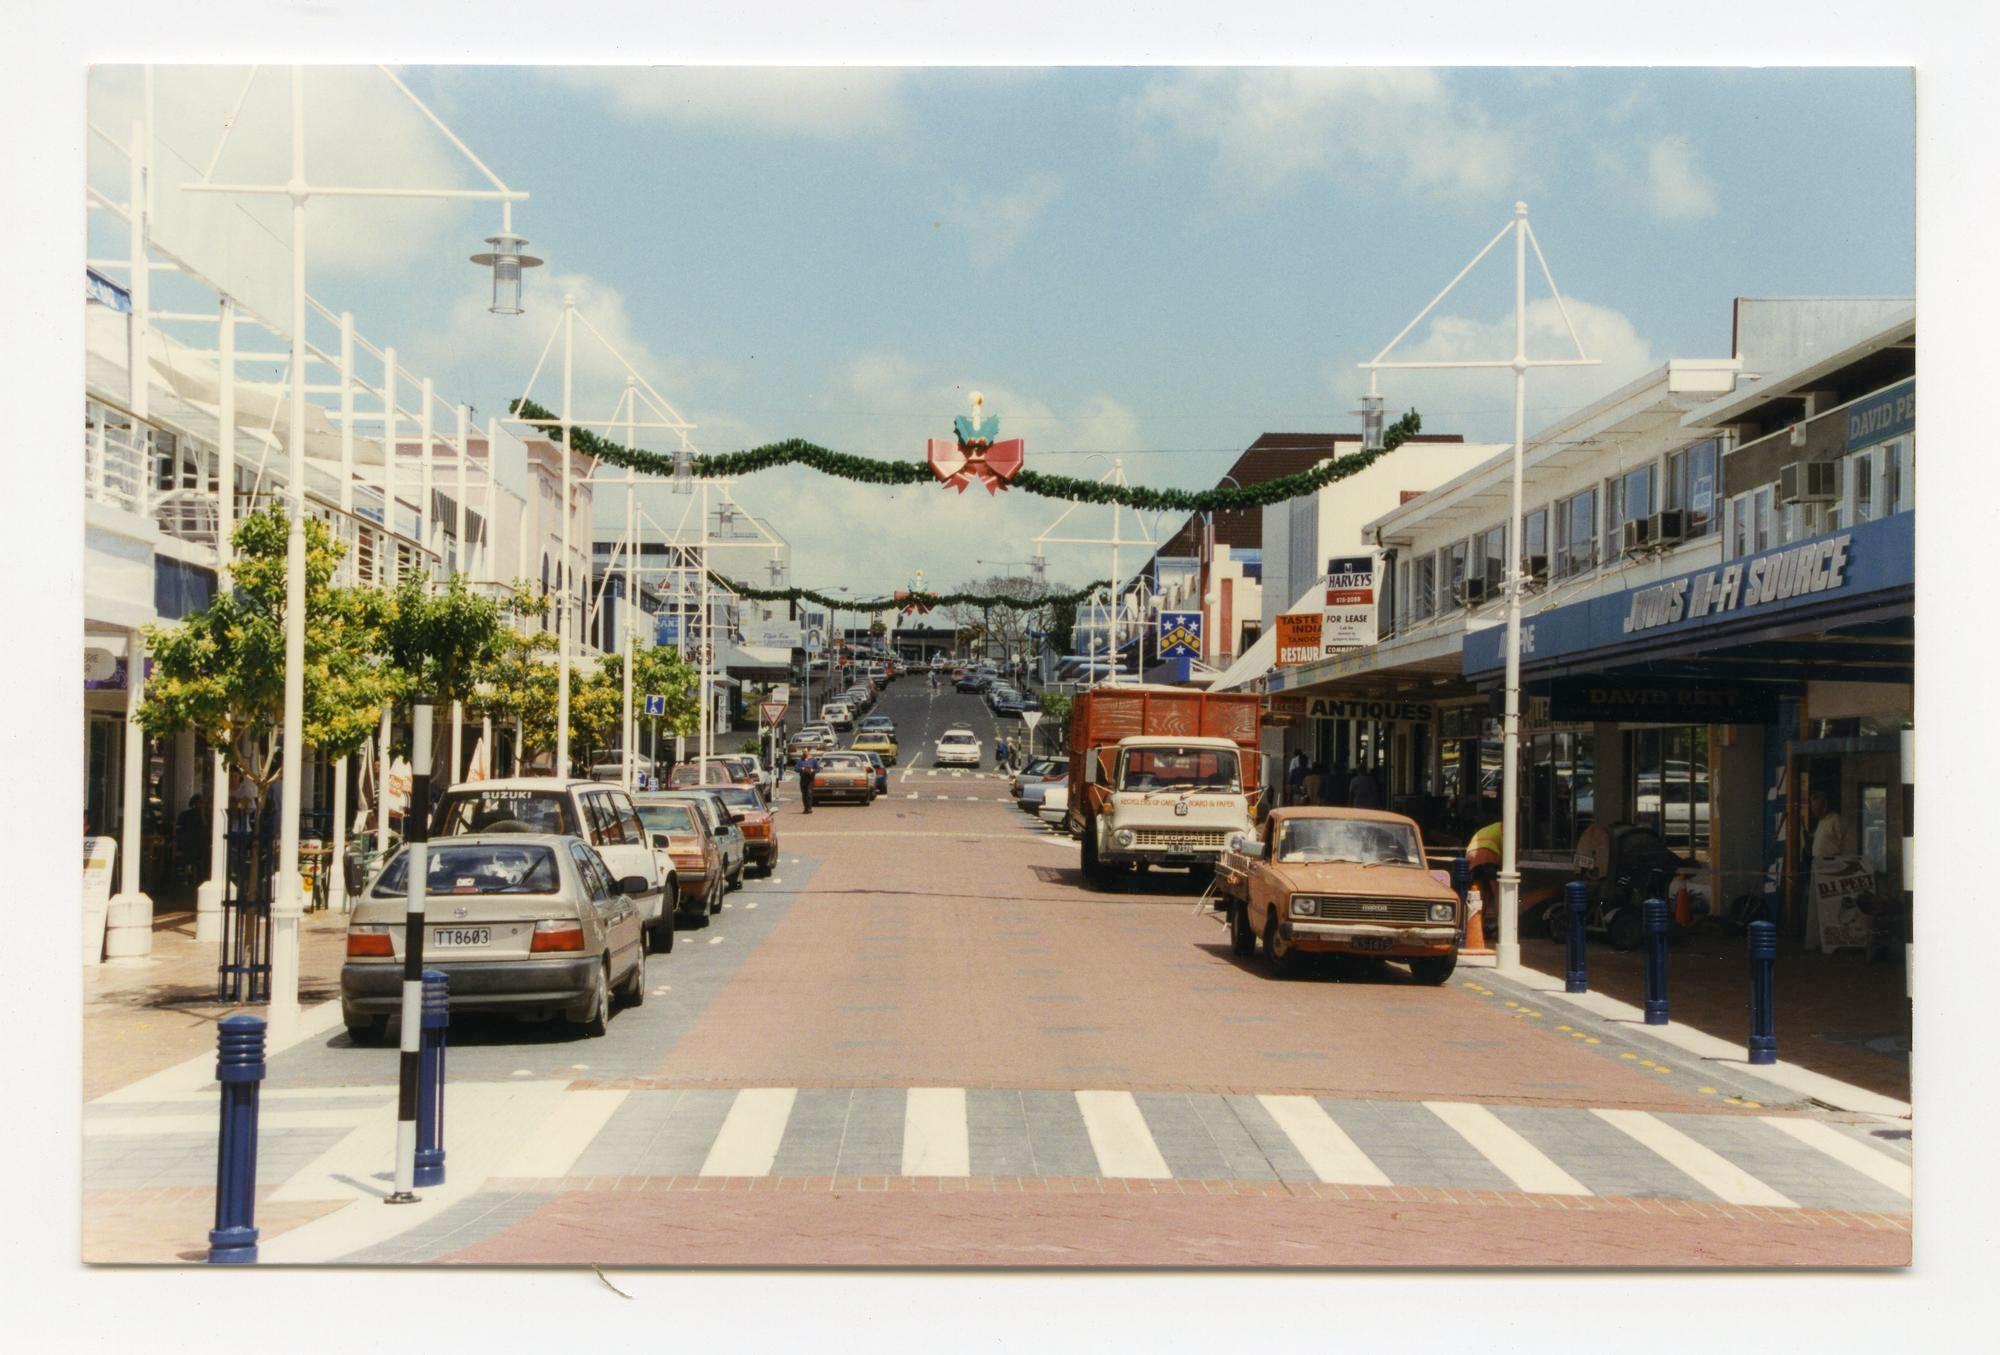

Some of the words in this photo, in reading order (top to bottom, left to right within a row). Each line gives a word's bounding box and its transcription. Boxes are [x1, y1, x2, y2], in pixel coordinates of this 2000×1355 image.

[1849, 403, 1893, 440] DAVID
[1745, 534, 1850, 607] SOURCE
[1328, 573, 1372, 588] HARVEYS
[1280, 615, 1319, 624] TASTE
[1326, 615, 1342, 623] FOR
[1345, 614, 1368, 623] LEASE
[1281, 646, 1320, 662] RESTAUR
[1310, 698, 1432, 720] ANTIQUES
[482, 791, 532, 799] SUZUKI
[436, 930, 489, 945] TT8603
